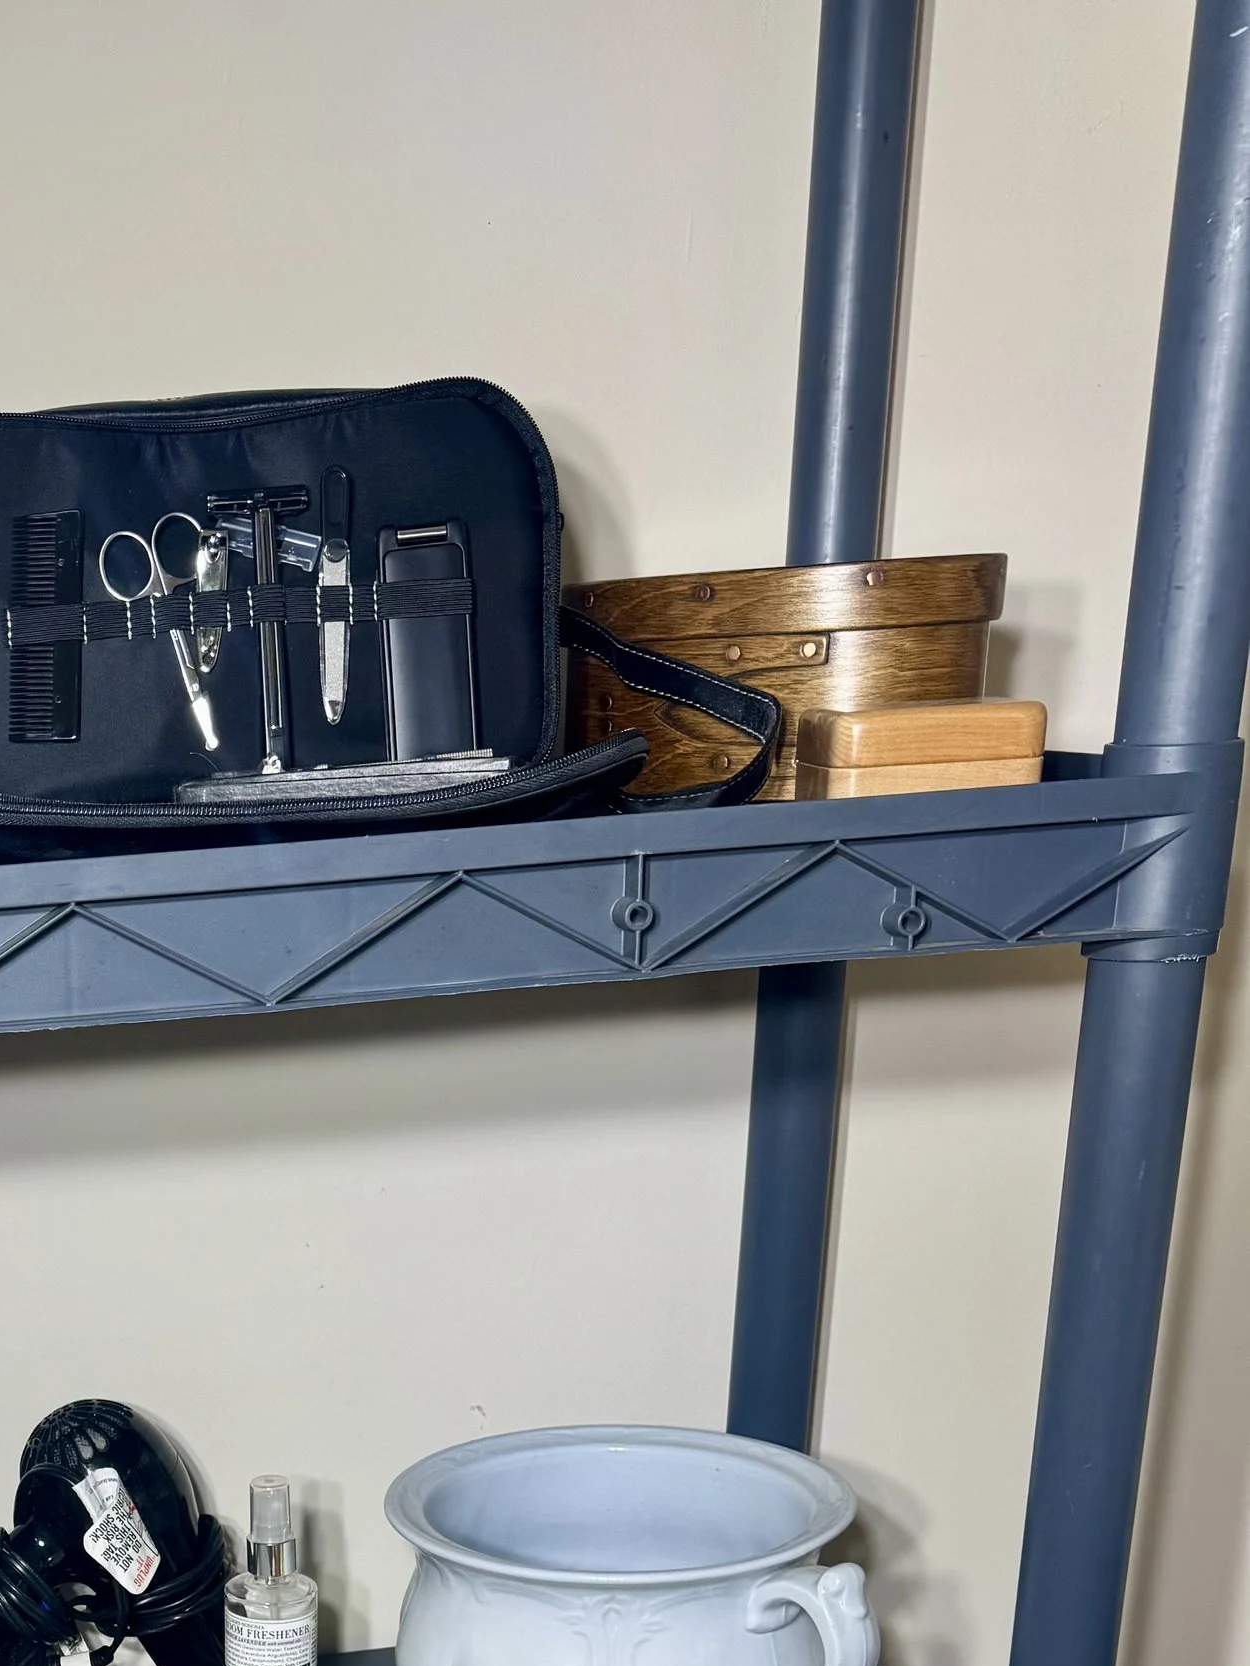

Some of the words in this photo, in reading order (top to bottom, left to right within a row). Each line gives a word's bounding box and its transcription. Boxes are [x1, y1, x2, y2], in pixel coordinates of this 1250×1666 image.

[116, 1508, 129, 1524] THE
[89, 1514, 114, 1543] SHOCK!
[103, 1523, 120, 1544] RISK
[115, 1525, 131, 1543] THIS
[101, 1543, 119, 1562] TAG!
[110, 1531, 137, 1566] REMOVE
[131, 1539, 142, 1553] DO
[118, 1554, 134, 1573] NOT
[247, 1624, 310, 1640] FRESHENER
